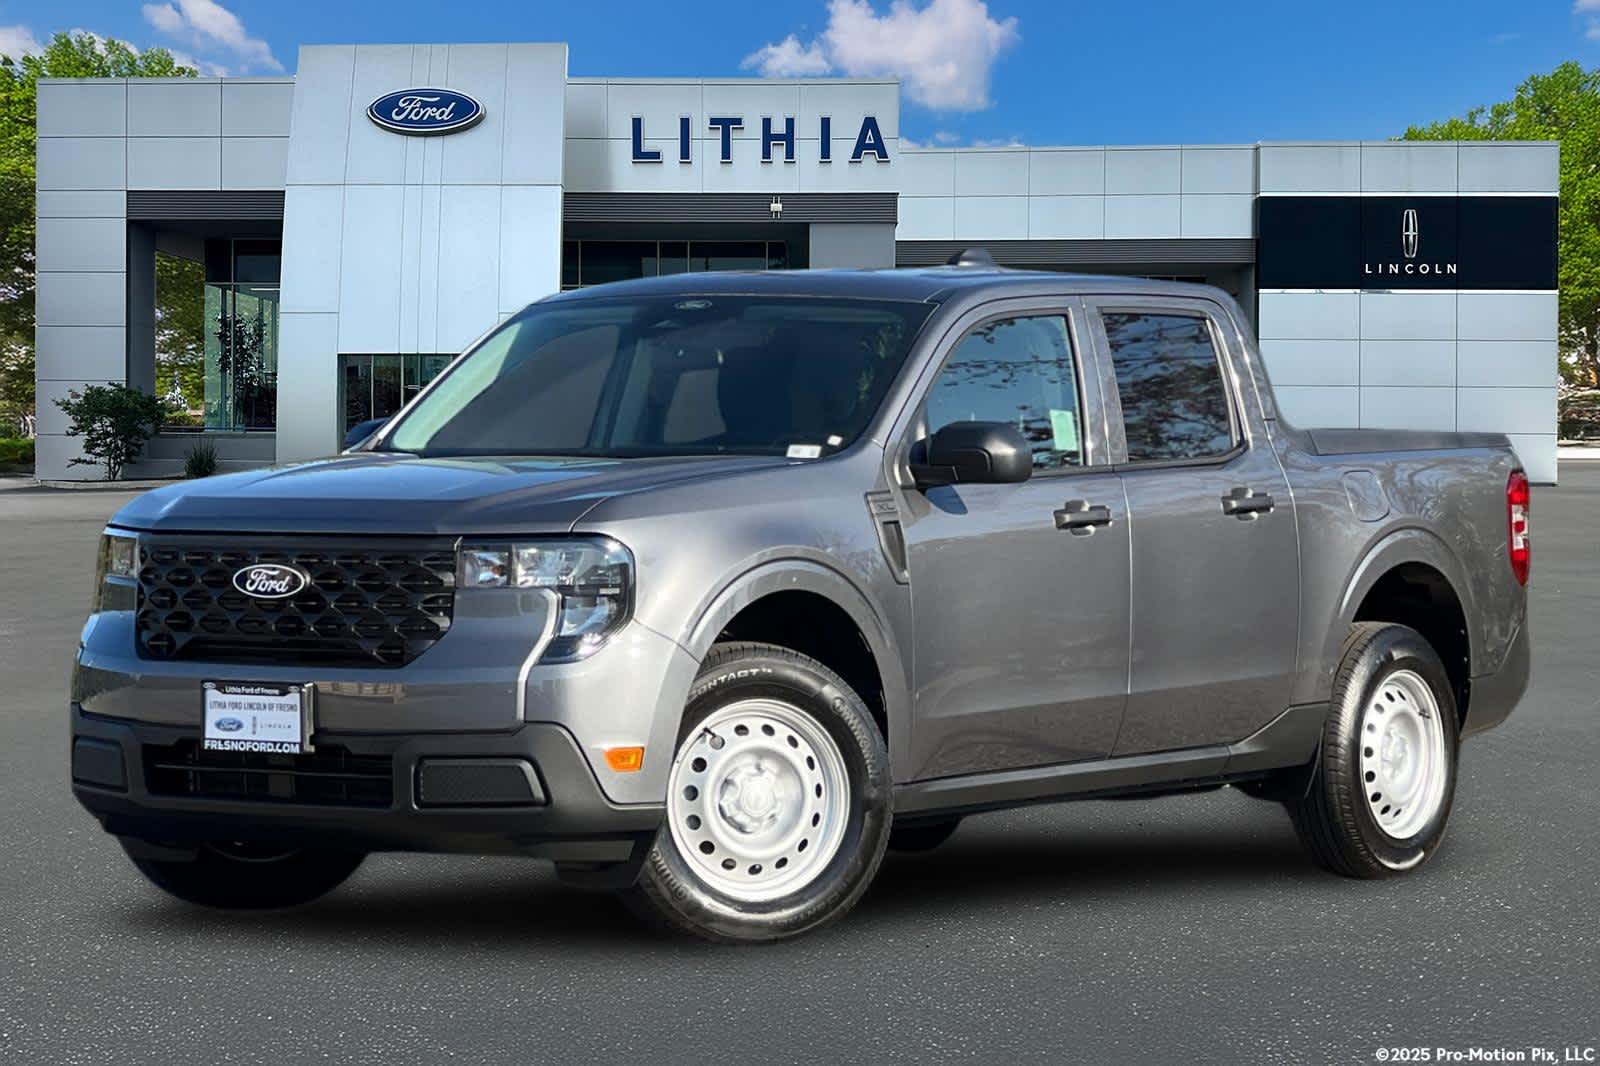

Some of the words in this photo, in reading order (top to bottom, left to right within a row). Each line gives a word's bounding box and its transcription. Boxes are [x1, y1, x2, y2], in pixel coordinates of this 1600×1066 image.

[391, 95, 456, 121] Ford
[631, 116, 890, 163] LITHIA
[1365, 263, 1457, 274] LINCOLN
[246, 568, 290, 593] Ford
[228, 701, 242, 711] FORD
[203, 740, 301, 754] FRESNOFORD.COM
